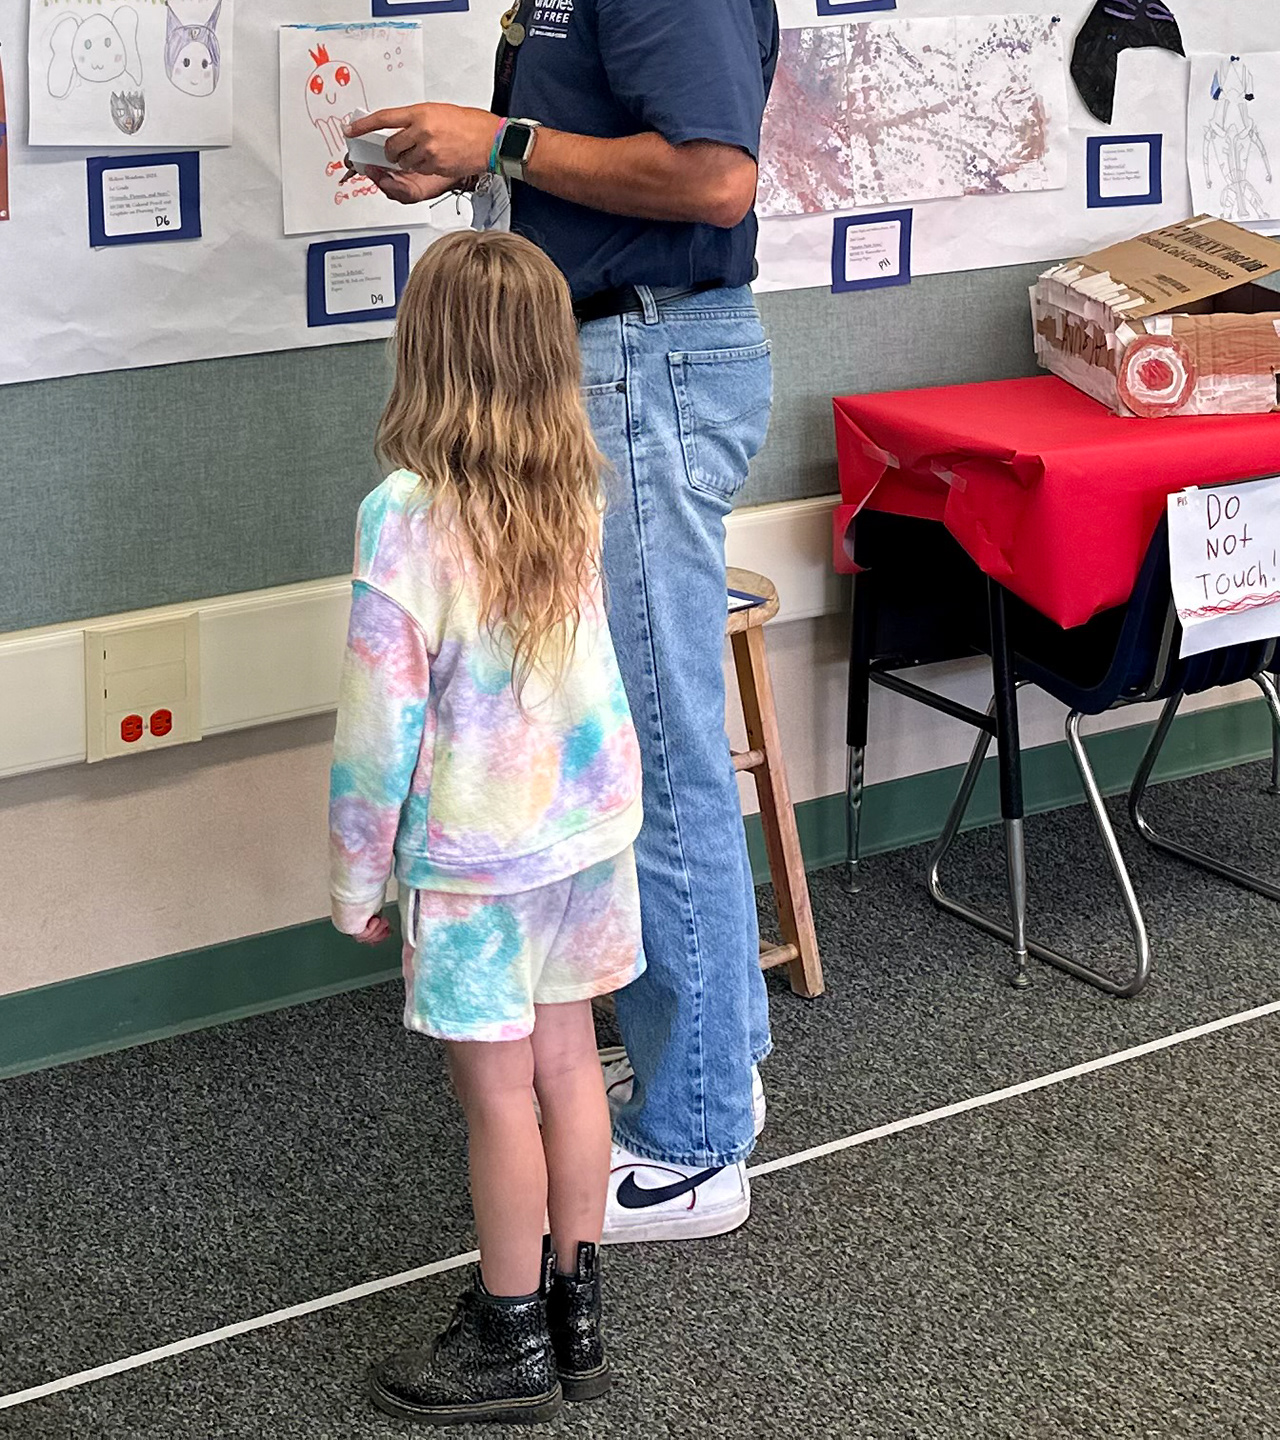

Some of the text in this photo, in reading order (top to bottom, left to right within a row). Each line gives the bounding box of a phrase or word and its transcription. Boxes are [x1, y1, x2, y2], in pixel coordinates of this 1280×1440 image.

[543, 11, 570, 24] FREE
[155, 215, 170, 227] D6
[371, 294, 384, 304] D9
[1206, 494, 1240, 530] DO
